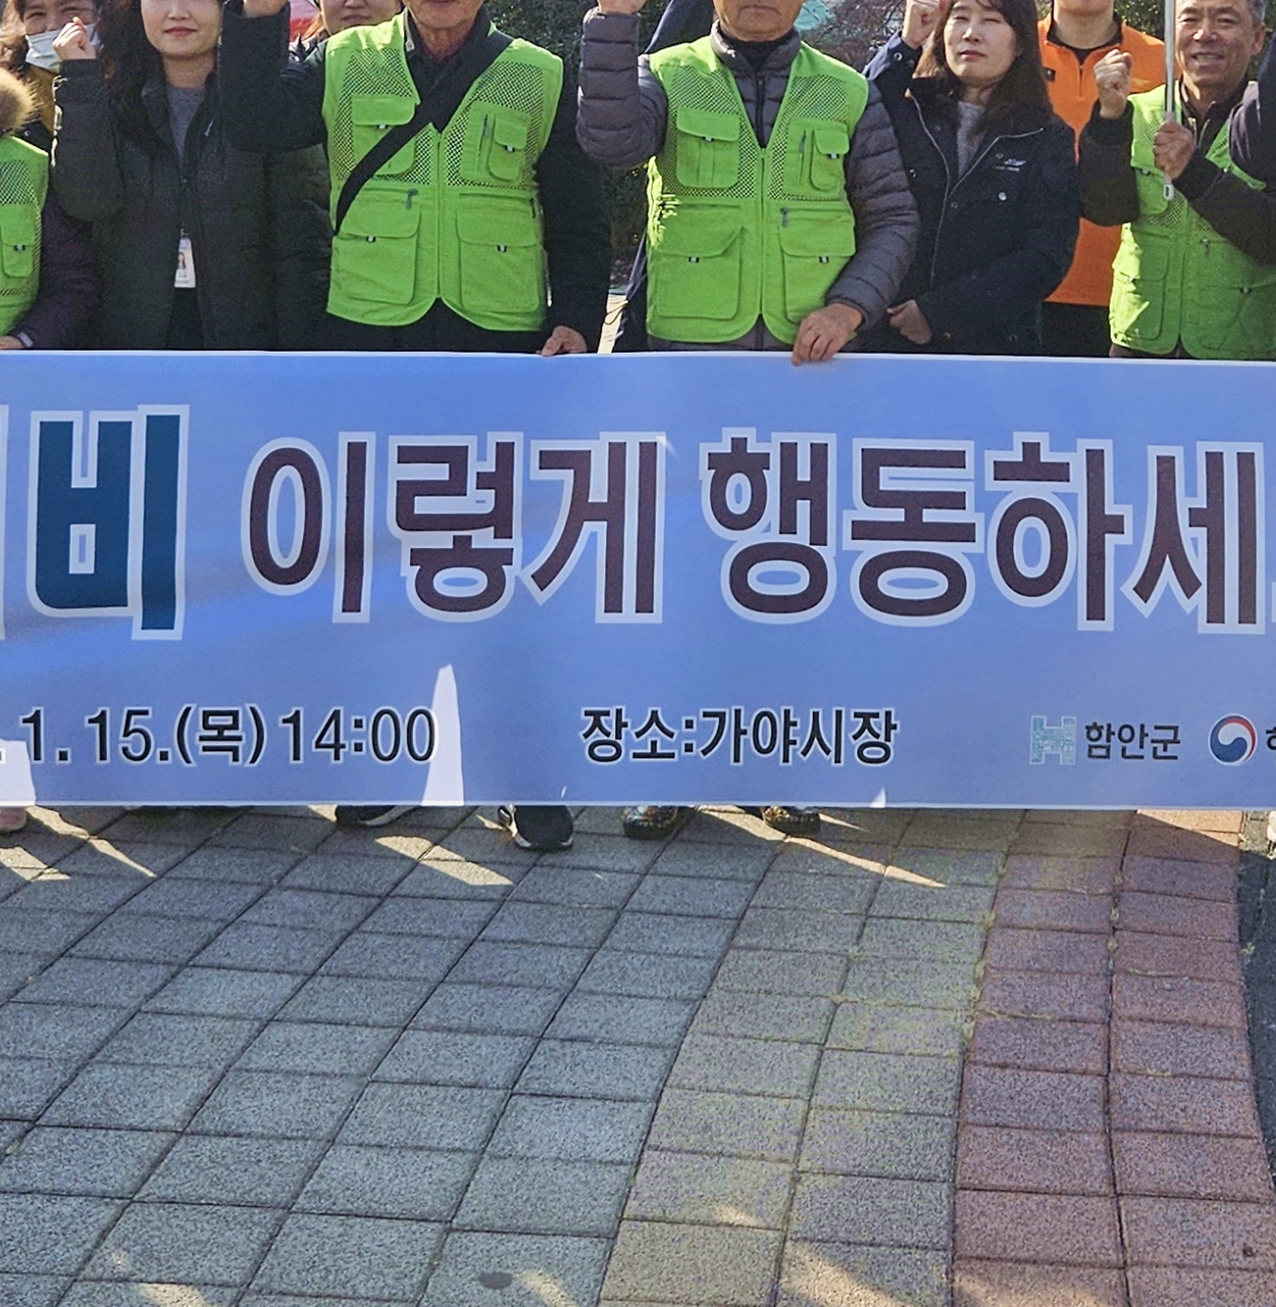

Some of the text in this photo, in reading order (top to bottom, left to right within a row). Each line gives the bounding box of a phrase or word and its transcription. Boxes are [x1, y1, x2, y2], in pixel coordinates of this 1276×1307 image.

[242, 431, 666, 623] 이렇게
[21, 706, 70, 765] 1.
[86, 705, 267, 767] 15.(목)
[281, 706, 437, 765] 14:00
[581, 705, 899, 767] 장소:가야시장
[1084, 721, 1181, 761] 함안군
